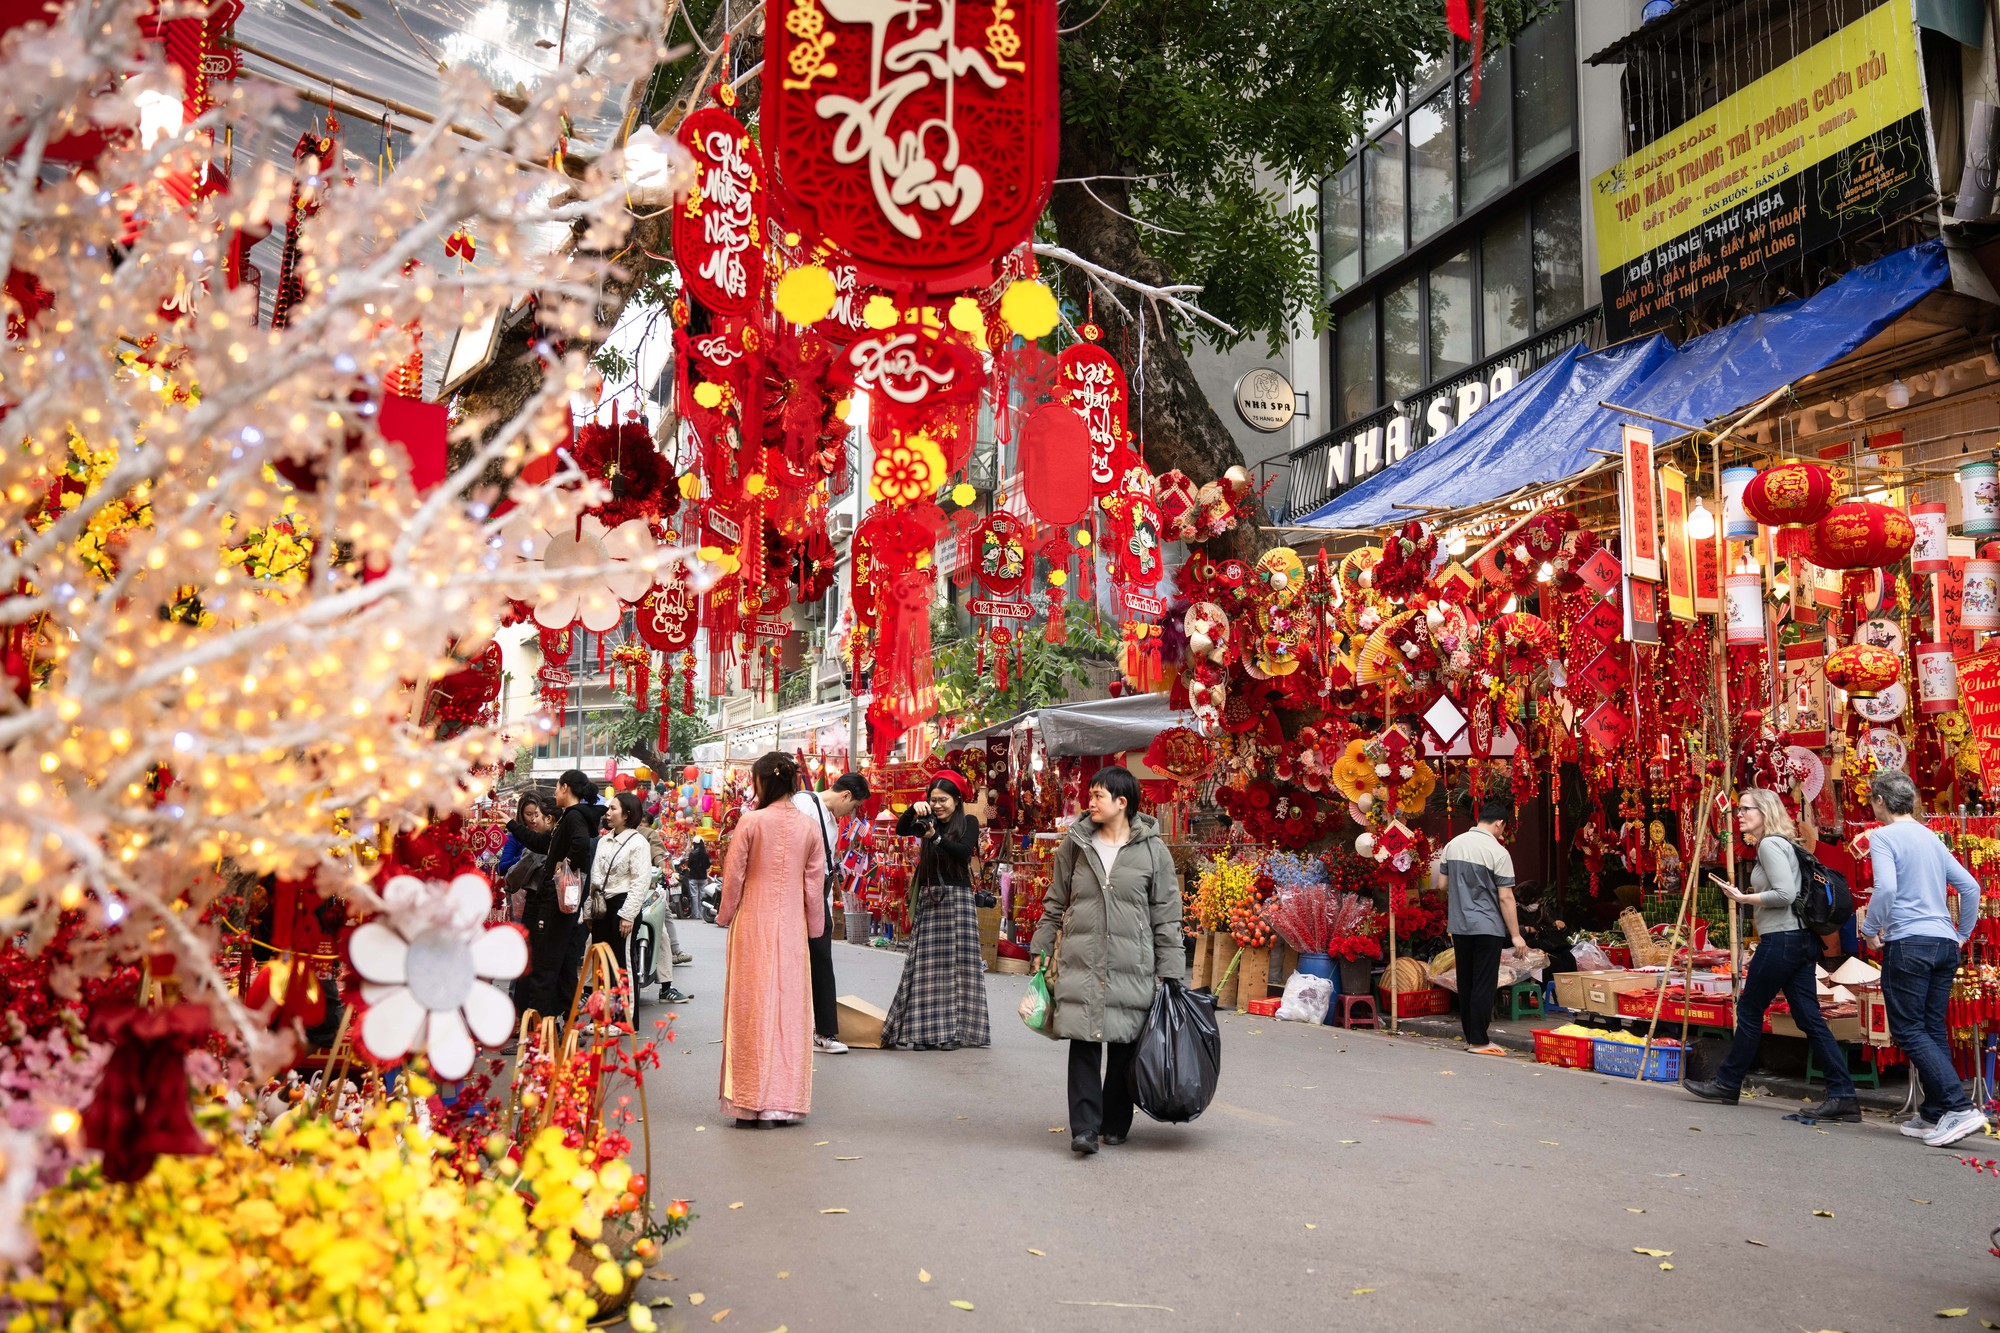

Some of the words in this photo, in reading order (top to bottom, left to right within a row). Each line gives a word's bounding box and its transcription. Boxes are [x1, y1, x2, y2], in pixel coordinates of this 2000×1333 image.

[1615, 193, 1641, 222] TẠO
[1643, 171, 1675, 207] MẪU
[1677, 146, 1724, 188] TRANG
[1726, 125, 1752, 160] TRÍ
[1856, 50, 1888, 89] HỎI
[1762, 134, 1805, 168] ALUMI
[1818, 107, 1858, 137] MIKA
[1858, 151, 1876, 172] 77
[1702, 200, 1720, 217] BÁN
[1722, 188, 1748, 206] BUÔN
[1755, 173, 1775, 189] BÁN
[1616, 290, 1637, 310] GIẤY
[1663, 265, 1686, 288] GIẤY
[1721, 236, 1746, 258] GIẤY
[1771, 204, 1807, 233] THUẬT
[1701, 264, 1730, 288] PHÁP
[1740, 249, 1762, 271] BÚT
[1765, 233, 1796, 258] LÔNG
[1244, 399, 1267, 410] NHÀ
[1270, 402, 1291, 411] SPA
[1326, 400, 1413, 489] NHÀ
[1426, 366, 1519, 444] SPA
